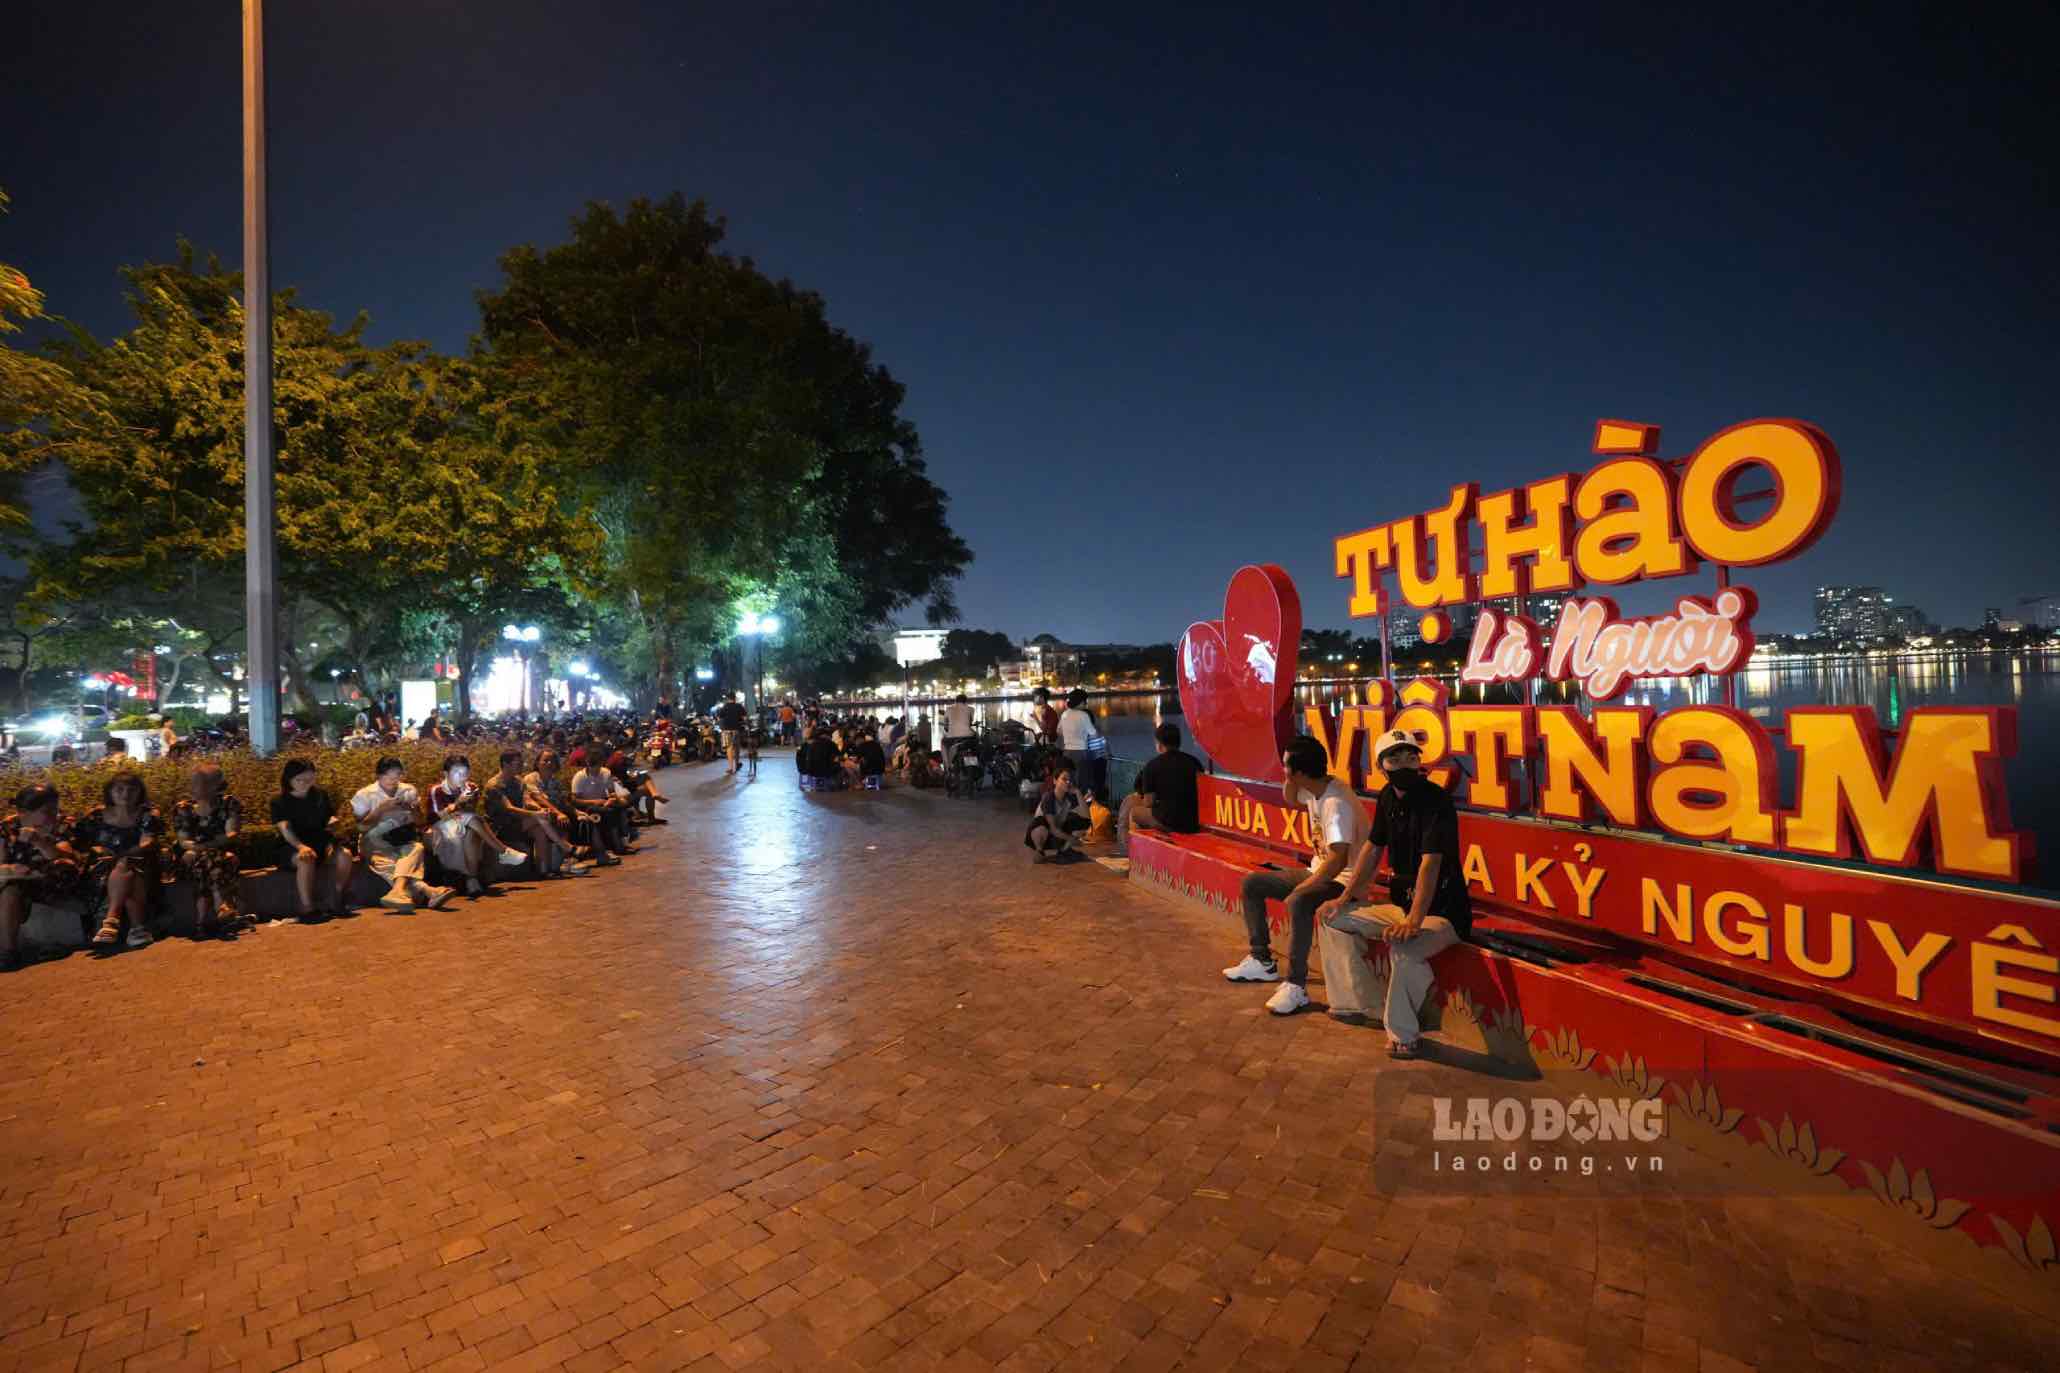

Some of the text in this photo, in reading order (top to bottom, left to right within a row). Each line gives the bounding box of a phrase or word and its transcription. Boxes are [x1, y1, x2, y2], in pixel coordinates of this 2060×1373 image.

[1462, 611, 1532, 681] Là
[1214, 787, 1271, 838] MÙA
[1515, 842, 1607, 918] KỶ
